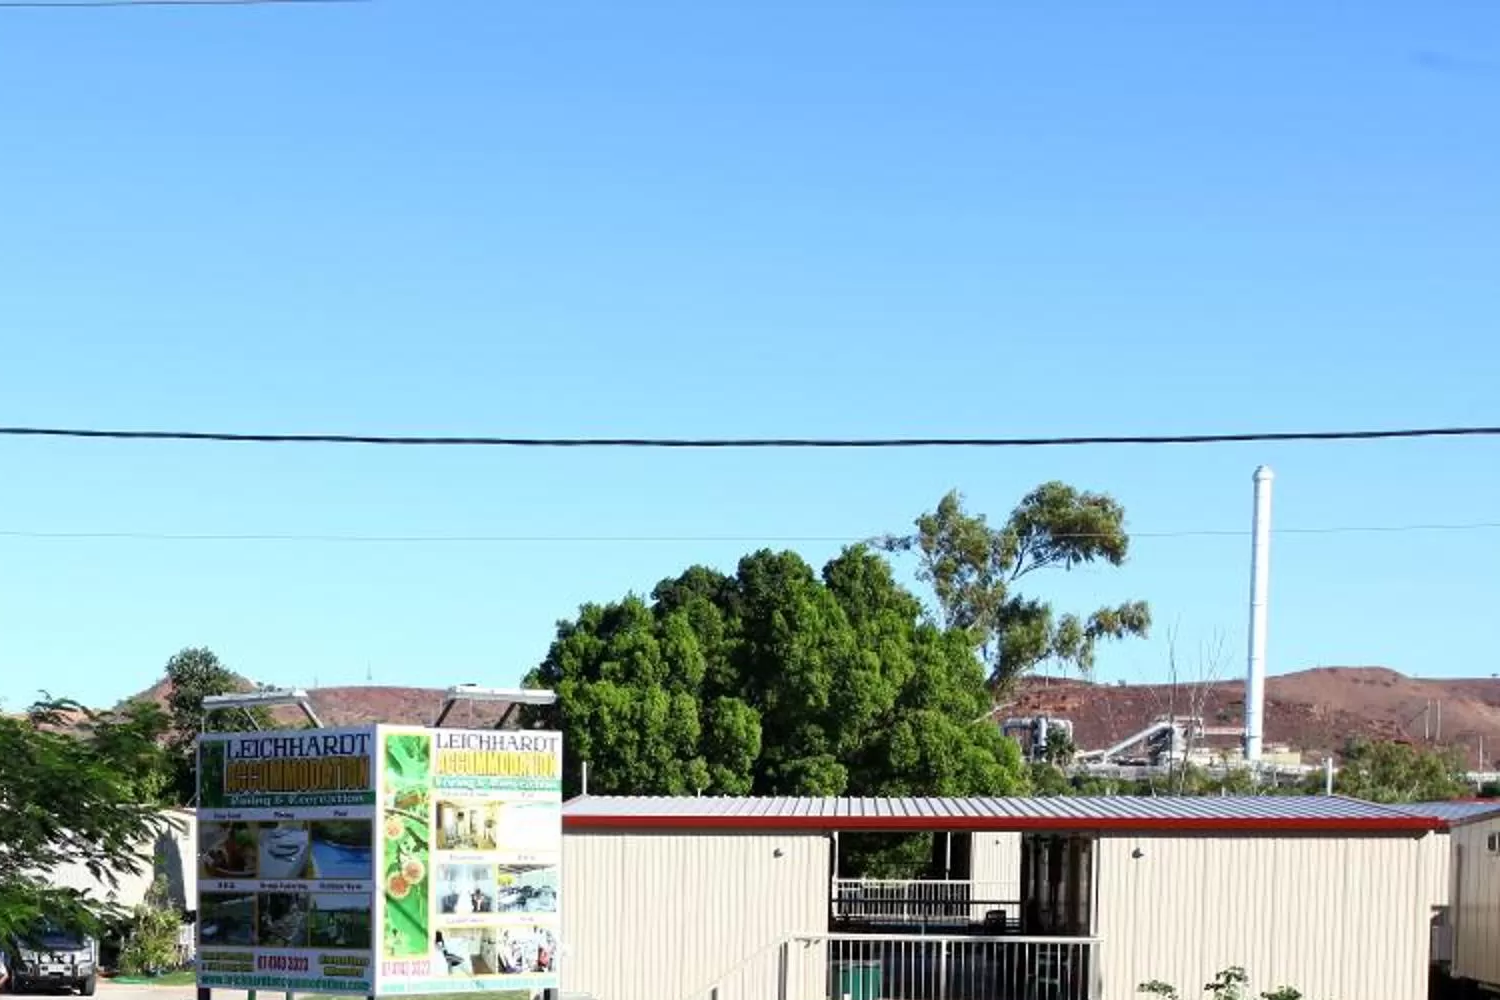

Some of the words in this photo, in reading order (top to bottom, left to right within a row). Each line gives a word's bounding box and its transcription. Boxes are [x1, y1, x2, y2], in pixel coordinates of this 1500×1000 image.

[227, 733, 371, 759] LEICHHARDT
[436, 732, 559, 752] LEICHHARDT
[226, 755, 370, 792] ACCOMMODATION
[436, 751, 557, 777] ACCOMMODATION
